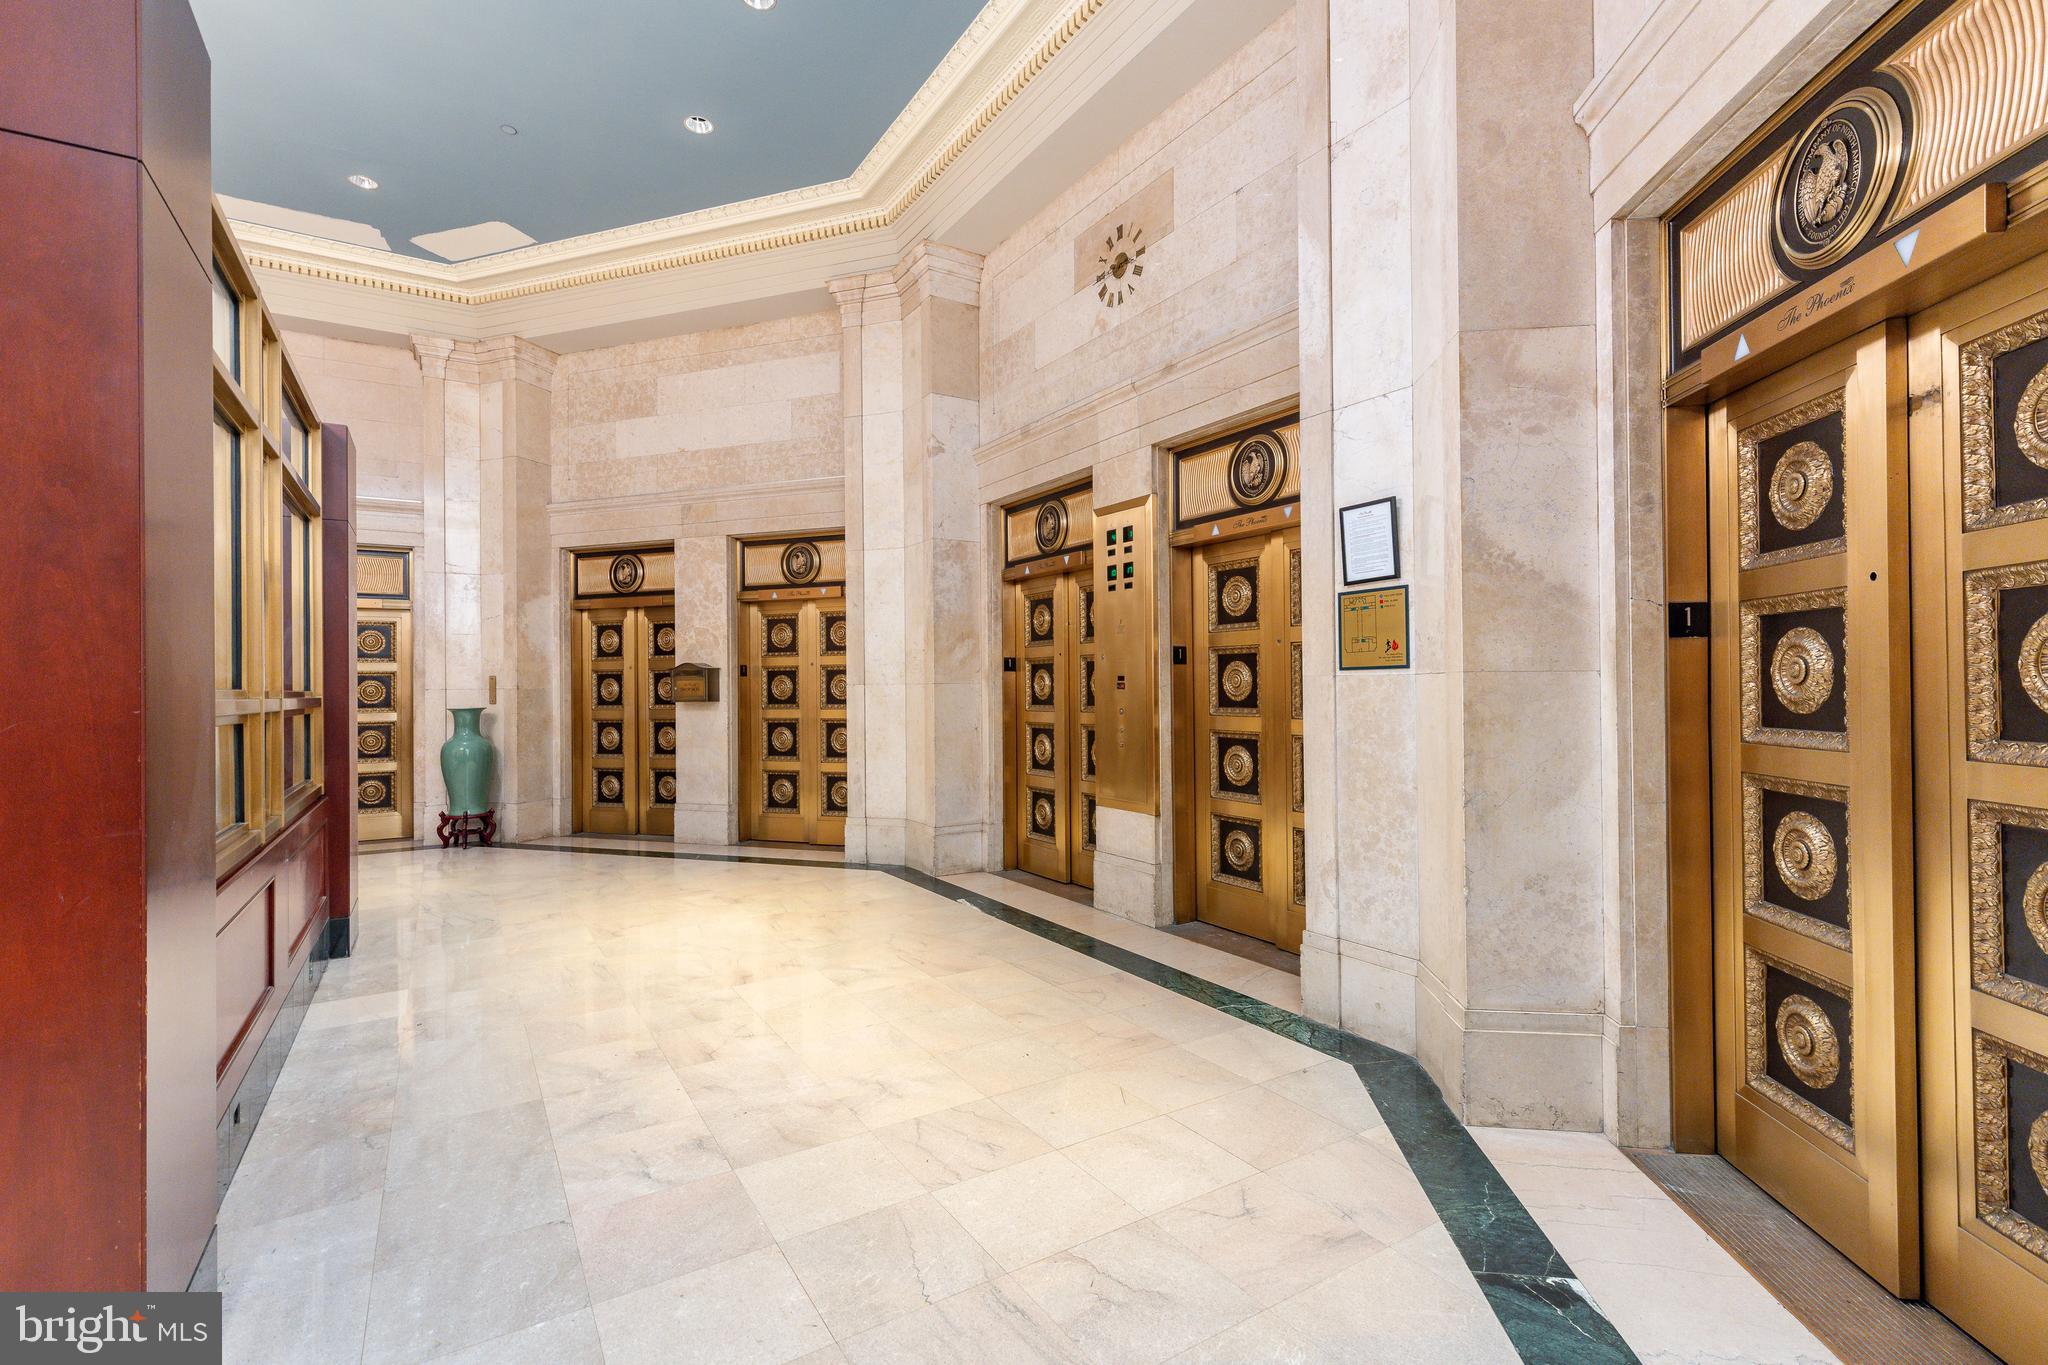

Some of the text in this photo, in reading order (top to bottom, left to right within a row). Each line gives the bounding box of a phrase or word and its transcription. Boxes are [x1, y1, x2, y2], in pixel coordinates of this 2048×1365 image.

[1841, 124, 1858, 149] NORTH
[1849, 149, 1860, 194] AMERICA
[1807, 225, 1837, 240] FOUNDED
[1098, 256, 1108, 264] X
[1777, 283, 1855, 332] The Phoenix
[1684, 606, 1691, 627] 1
